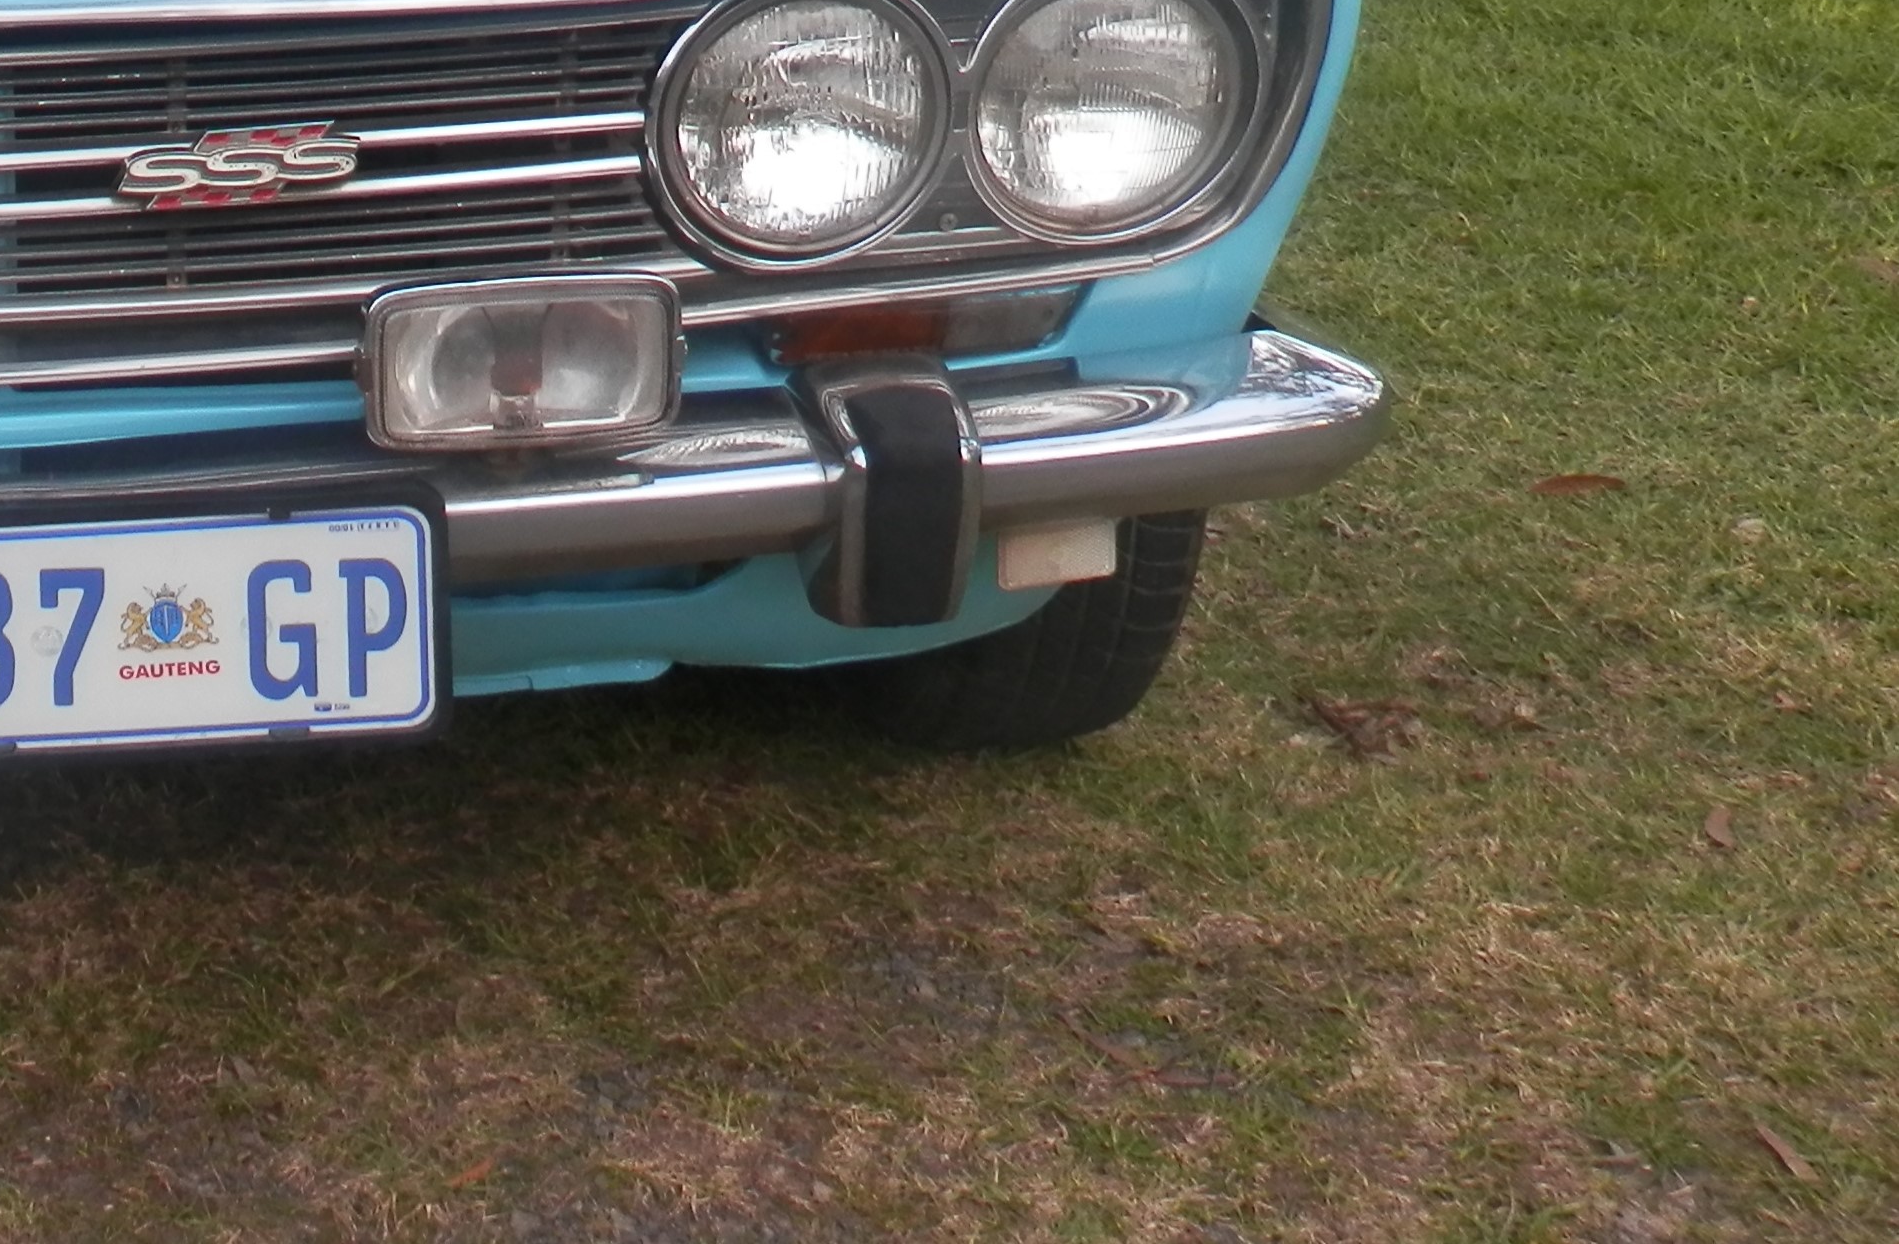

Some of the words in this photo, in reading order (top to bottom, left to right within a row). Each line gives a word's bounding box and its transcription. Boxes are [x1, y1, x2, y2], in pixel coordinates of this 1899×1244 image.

[118, 137, 361, 194] SSS
[247, 558, 407, 700] GP
[119, 660, 220, 680] GAUTENG
